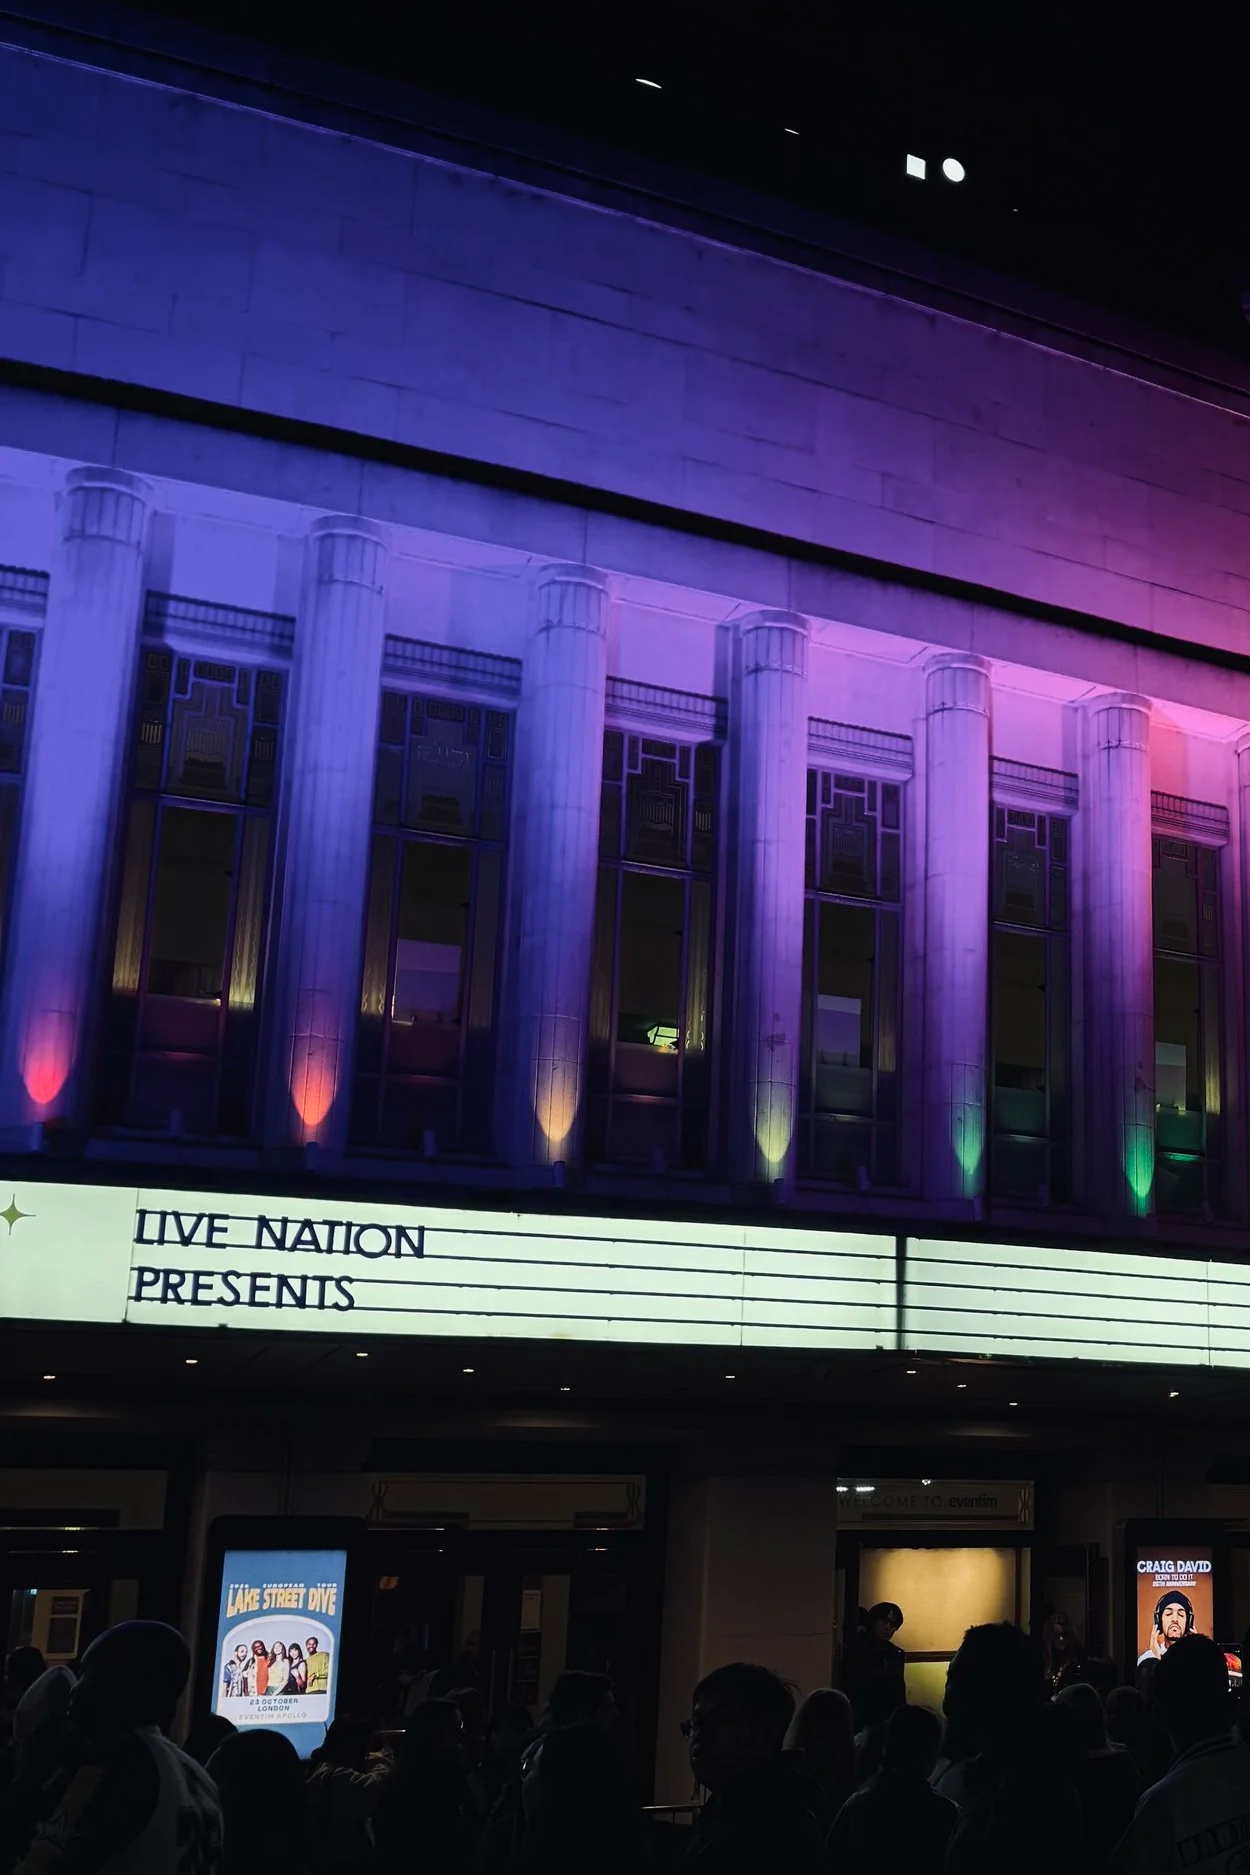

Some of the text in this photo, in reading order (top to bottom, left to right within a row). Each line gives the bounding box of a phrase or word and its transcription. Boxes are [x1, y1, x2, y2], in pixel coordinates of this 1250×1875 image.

[134, 1209, 425, 1259] LIVE NATION
[133, 1267, 355, 1311] PRESENTS
[924, 1495, 943, 1508] TO
[948, 1493, 998, 1508] eventim
[1137, 1560, 1212, 1573] CRAIG DAVID
[226, 1587, 337, 1618] LAKE STREET DIVE
